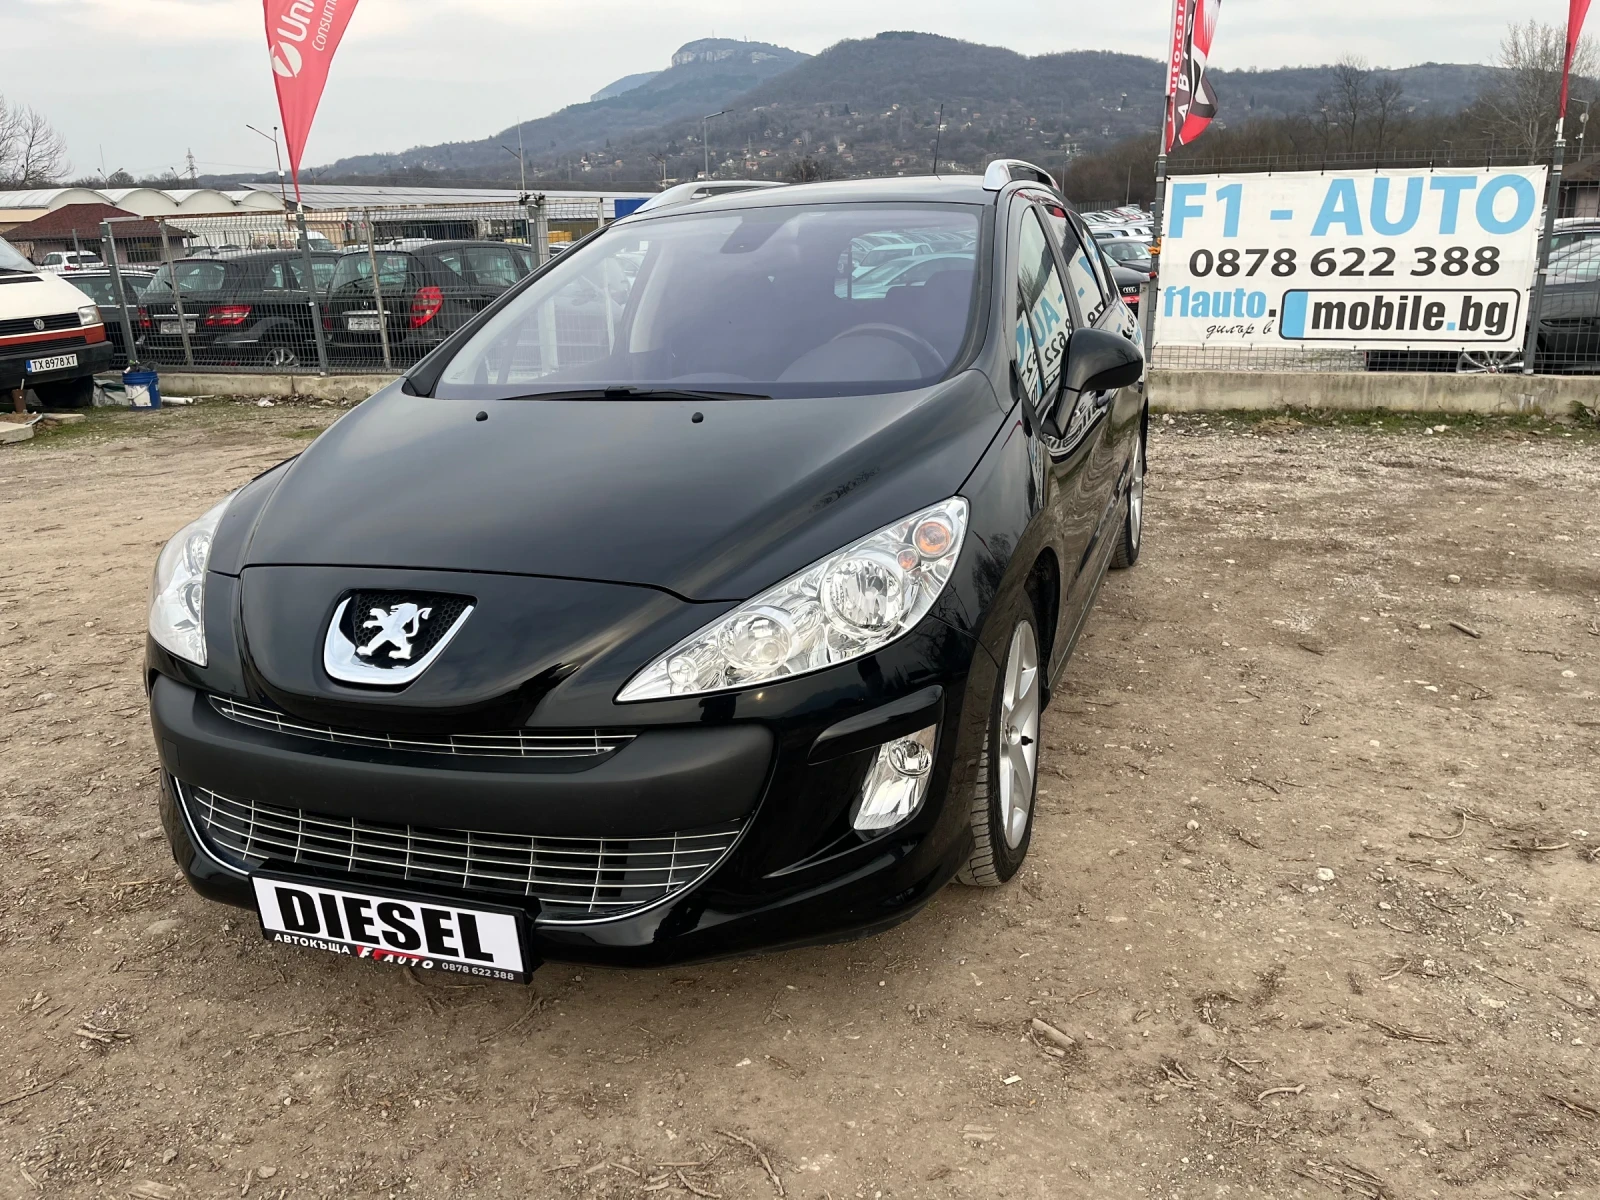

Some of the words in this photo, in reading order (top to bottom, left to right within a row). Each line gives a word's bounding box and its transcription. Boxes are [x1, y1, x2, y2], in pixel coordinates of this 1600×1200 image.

[1168, 182, 1243, 238] F1
[1270, 209, 1294, 220] -
[1310, 174, 1536, 237] AUTO
[1189, 248, 1297, 278] 0878
[1310, 247, 1396, 277] 622
[1410, 246, 1500, 276] 388
[1312, 295, 1509, 335] mobile.bg
[32, 360, 44, 370] TX
[45, 357, 65, 369] 8978
[65, 355, 76, 366] XT
[274, 886, 494, 963] DIESEL
[274, 933, 351, 954] АВТОКЪЩА
[384, 954, 434, 969] AUTO
[442, 962, 469, 973] 0878
[472, 967, 491, 977] 622
[493, 970, 514, 980] 388
